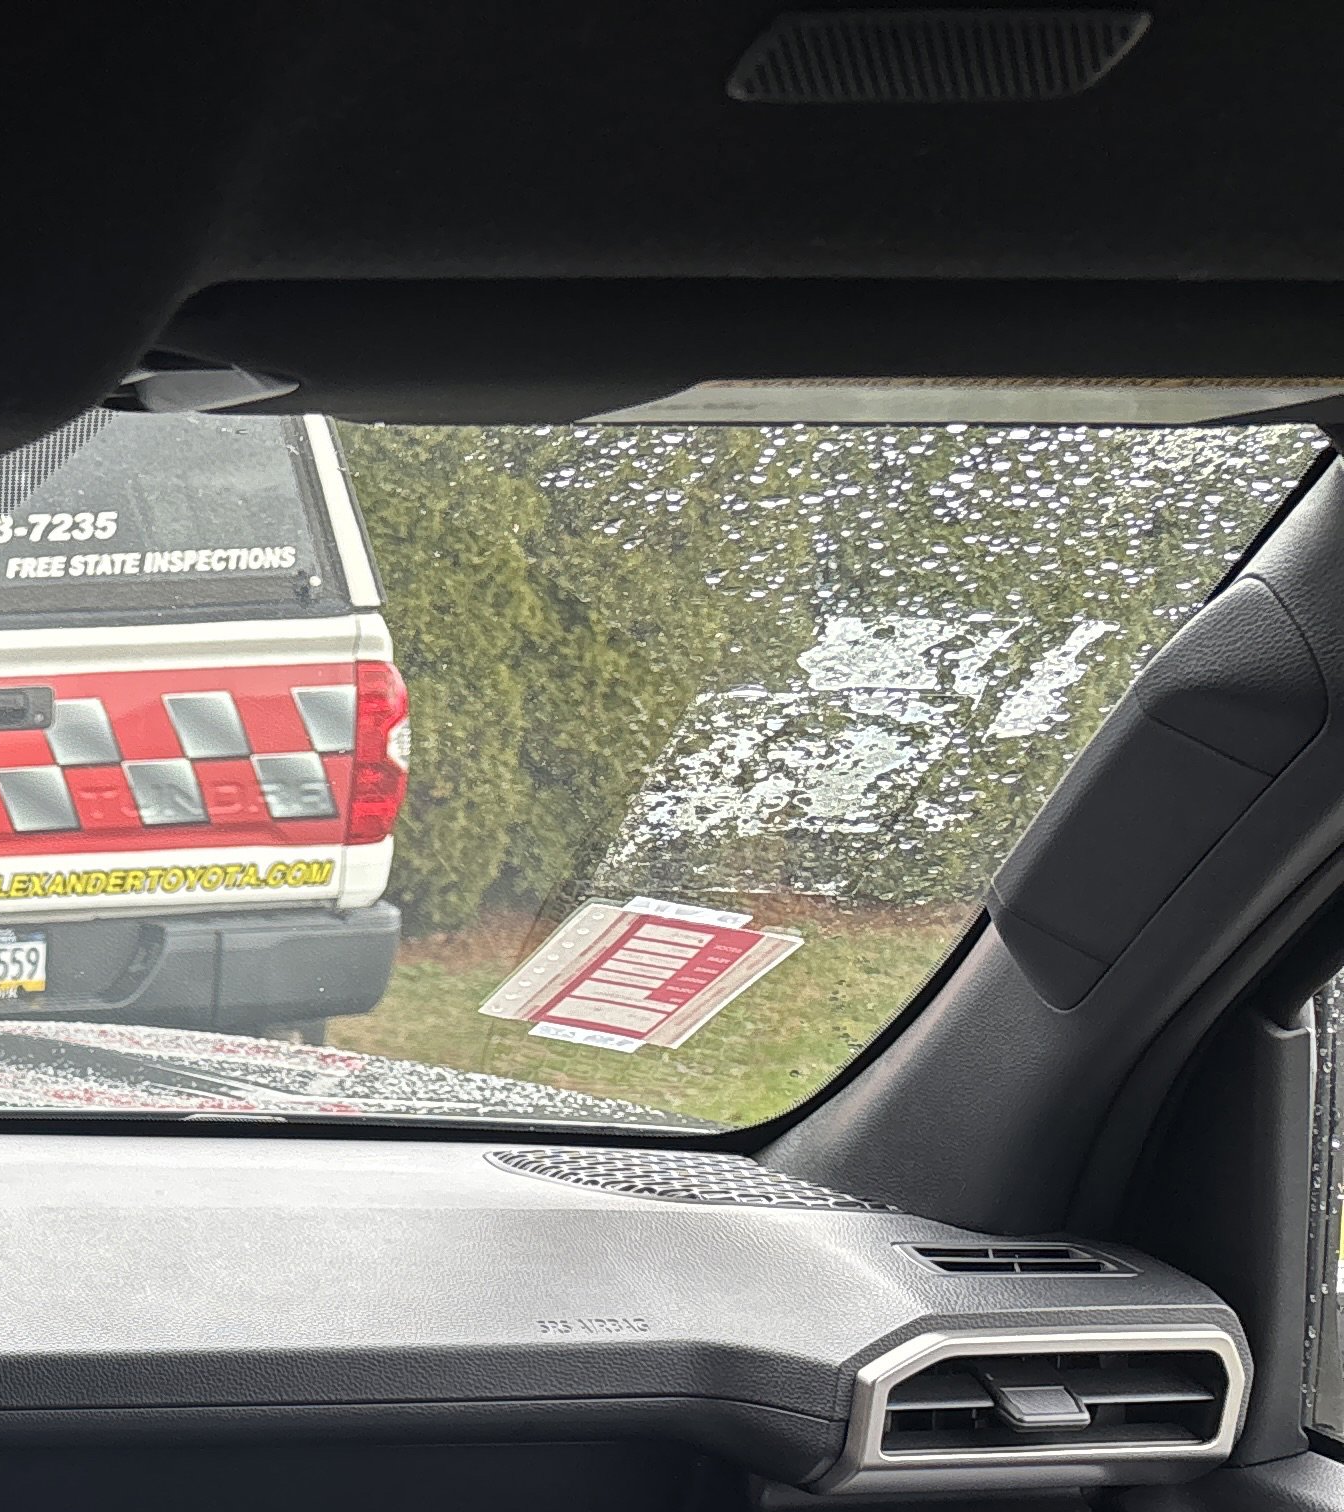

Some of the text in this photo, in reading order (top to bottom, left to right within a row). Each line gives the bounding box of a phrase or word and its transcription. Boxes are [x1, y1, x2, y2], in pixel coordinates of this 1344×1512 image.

[5, 556, 67, 579] FREE
[69, 551, 142, 576] STATE
[143, 546, 296, 574] INSPECTIONS
